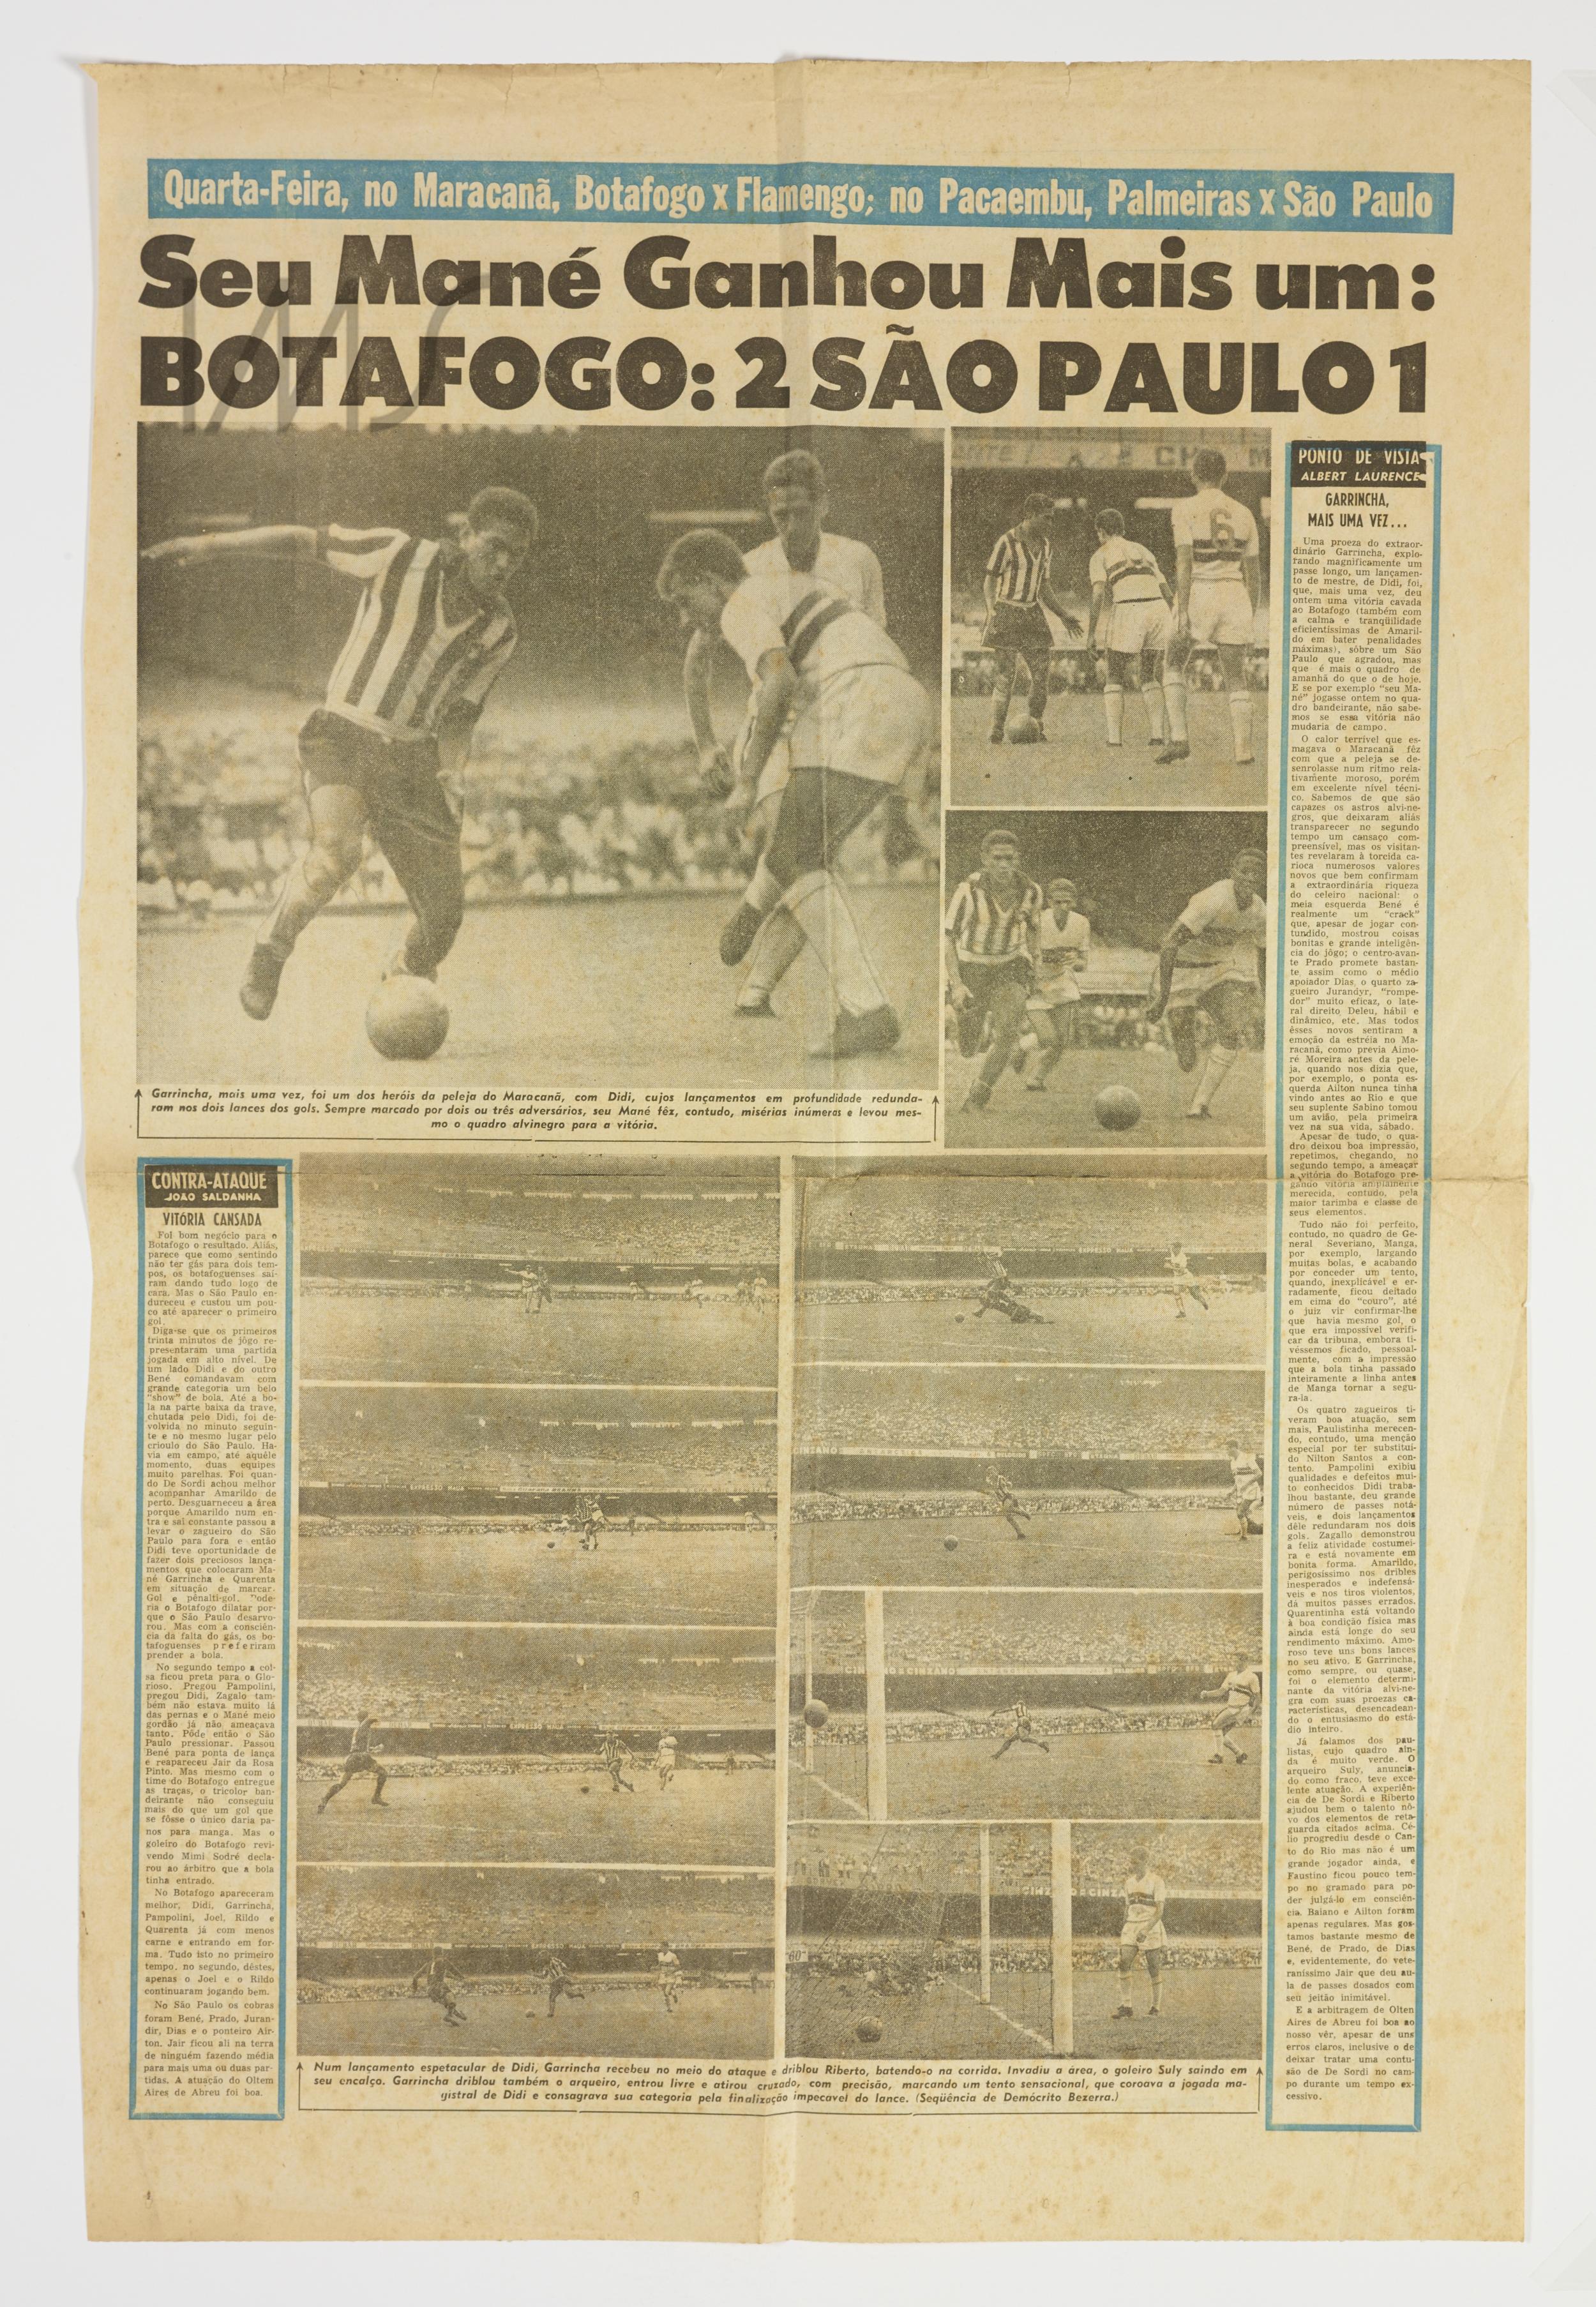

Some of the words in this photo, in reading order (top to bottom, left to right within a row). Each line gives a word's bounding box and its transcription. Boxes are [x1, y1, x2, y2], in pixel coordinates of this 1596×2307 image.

[164, 169, 349, 213] Quarta-Feira,
[365, 181, 398, 207] no
[414, 172, 560, 214] Maracanã,
[575, 174, 705, 219] Botafogo
[712, 184, 728, 210] x
[737, 176, 874, 219] Flamengo;
[890, 186, 924, 213] no
[939, 177, 1092, 222] Pacaembu,
[1108, 179, 1251, 217] Palmeiras
[1259, 188, 1276, 215] x
[1283, 180, 1336, 218] São
[1353, 181, 1433, 218] Paulo
[138, 234, 312, 309] Seu
[334, 234, 601, 310] Mané
[623, 234, 984, 310] Ganhou
[1006, 236, 1233, 311] Mais
[1256, 263, 1435, 312] um:
[140, 334, 715, 412] BOTAFOGO:
[735, 336, 791, 409] 2
[809, 323, 1018, 414] SÃO
[1038, 340, 1374, 415] PAULO
[1389, 341, 1427, 413] 1
[1299, 447, 1343, 464] PONTO
[1356, 448, 1372, 464] DE
[1384, 448, 1420, 465] VISTA
[1300, 471, 1347, 481] ALBERT
[1355, 472, 1420, 481] LAURENCE
[1325, 492, 1389, 508] GARRINCHA,
[1308, 513, 1334, 527] MAIS
[1339, 513, 1364, 528] UMA
[1210, 508, 1235, 550] 6
[1293, 546, 1326, 555] dinário
[1336, 548, 1385, 558] Garrincha,
[1394, 550, 1423, 559] explo-
[1353, 597, 1384, 606] vitória
[1390, 598, 1422, 606] cavada
[151, 1088, 212, 1100] Garrincha,
[218, 1088, 245, 1099] mais
[282, 1092, 305, 1101] vez,
[311, 1089, 326, 1099] foi
[356, 1090, 375, 1100] dos
[382, 1090, 416, 1101] heróis
[421, 1090, 435, 1101] da
[441, 1090, 477, 1103] peleja
[483, 1090, 497, 1101] do
[502, 1090, 565, 1103] Maracanã,
[608, 1091, 635, 1103] Didi,
[645, 1092, 674, 1104] cujos
[684, 1092, 757, 1104] lançamentos
[792, 1092, 862, 1106] profundidade
[872, 1093, 922, 1103] redunda-
[1309, 1103, 1348, 1113] suplente
[1353, 1103, 1384, 1111] Sabino
[467, 1118, 507, 1131] quadro
[512, 1118, 565, 1131] alvinegro
[571, 1122, 598, 1132] para
[617, 1119, 658, 1130] vitória.
[151, 1171, 267, 1190] CONTRA-ATAQUE
[202, 1192, 262, 1201] SALDANHA
[162, 1212, 206, 1226] VITÓRIA
[213, 1212, 262, 1226] CANSADA
[147, 1240, 190, 1250] Botafogo
[202, 1240, 248, 1249] resultado.
[252, 1241, 278, 1251] Aliás,
[1363, 1374, 1387, 1382] linha
[148, 1489, 206, 1499] acompanhar
[214, 1489, 257, 1497] Amarildo
[265, 1489, 276, 1497] de
[1286, 1638, 1340, 1646] rendimento
[1345, 1636, 1385, 1645] máximo.
[146, 1767, 173, 1775] Pinto.
[179, 1767, 198, 1776] Mas
[145, 1900, 181, 1910] melhor,
[192, 1901, 214, 1910] Didi,
[225, 1901, 274, 1911] Garrincha,
[1308, 1994, 1334, 2003] jeitão
[1341, 1994, 1390, 2002] inimitável.
[313, 2061, 342, 2071] Num
[349, 2062, 414, 2074] lançamento
[420, 2062, 486, 2075] espetacular
[492, 2062, 506, 2073] de
[511, 2062, 538, 2074] Didi,
[544, 2062, 601, 2073] Garrincha
[606, 2063, 650, 2074] recebeu
[675, 2065, 702, 2075] meio
[708, 2065, 722, 2076] do
[727, 2067, 767, 2079] ataque
[782, 2063, 818, 2075] driblou
[825, 2064, 869, 2077] Riberto,
[875, 2065, 933, 2075] batendo-o
[958, 2065, 1001, 2075] corrida.
[1007, 2065, 1050, 2075] Invadiu
[1069, 2065, 1096, 2076] área,
[1114, 2065, 1152, 2077] goleiro
[1158, 2064, 1182, 2077] Suly
[1188, 2064, 1224, 2075] saindo
[144, 2088, 169, 2096] Aires
[174, 2088, 186, 2096] de
[191, 2088, 220, 2096] Abreu
[226, 2088, 238, 2096] foi
[483, 2089, 497, 2100] de
[503, 2089, 527, 2100] Didi
[545, 2093, 608, 2103] consagrava
[639, 2092, 692, 2104] categoria
[698, 2093, 722, 2105] pela
[728, 2093, 788, 2104] finalização
[855, 2093, 869, 2103] do
[875, 2093, 909, 2103] lance.
[915, 2093, 976, 2105] (Seqüência
[982, 2092, 997, 2102] de
[1004, 2092, 1062, 2102] Demócrito
[1068, 2091, 1118, 2102] Bezerra.)
